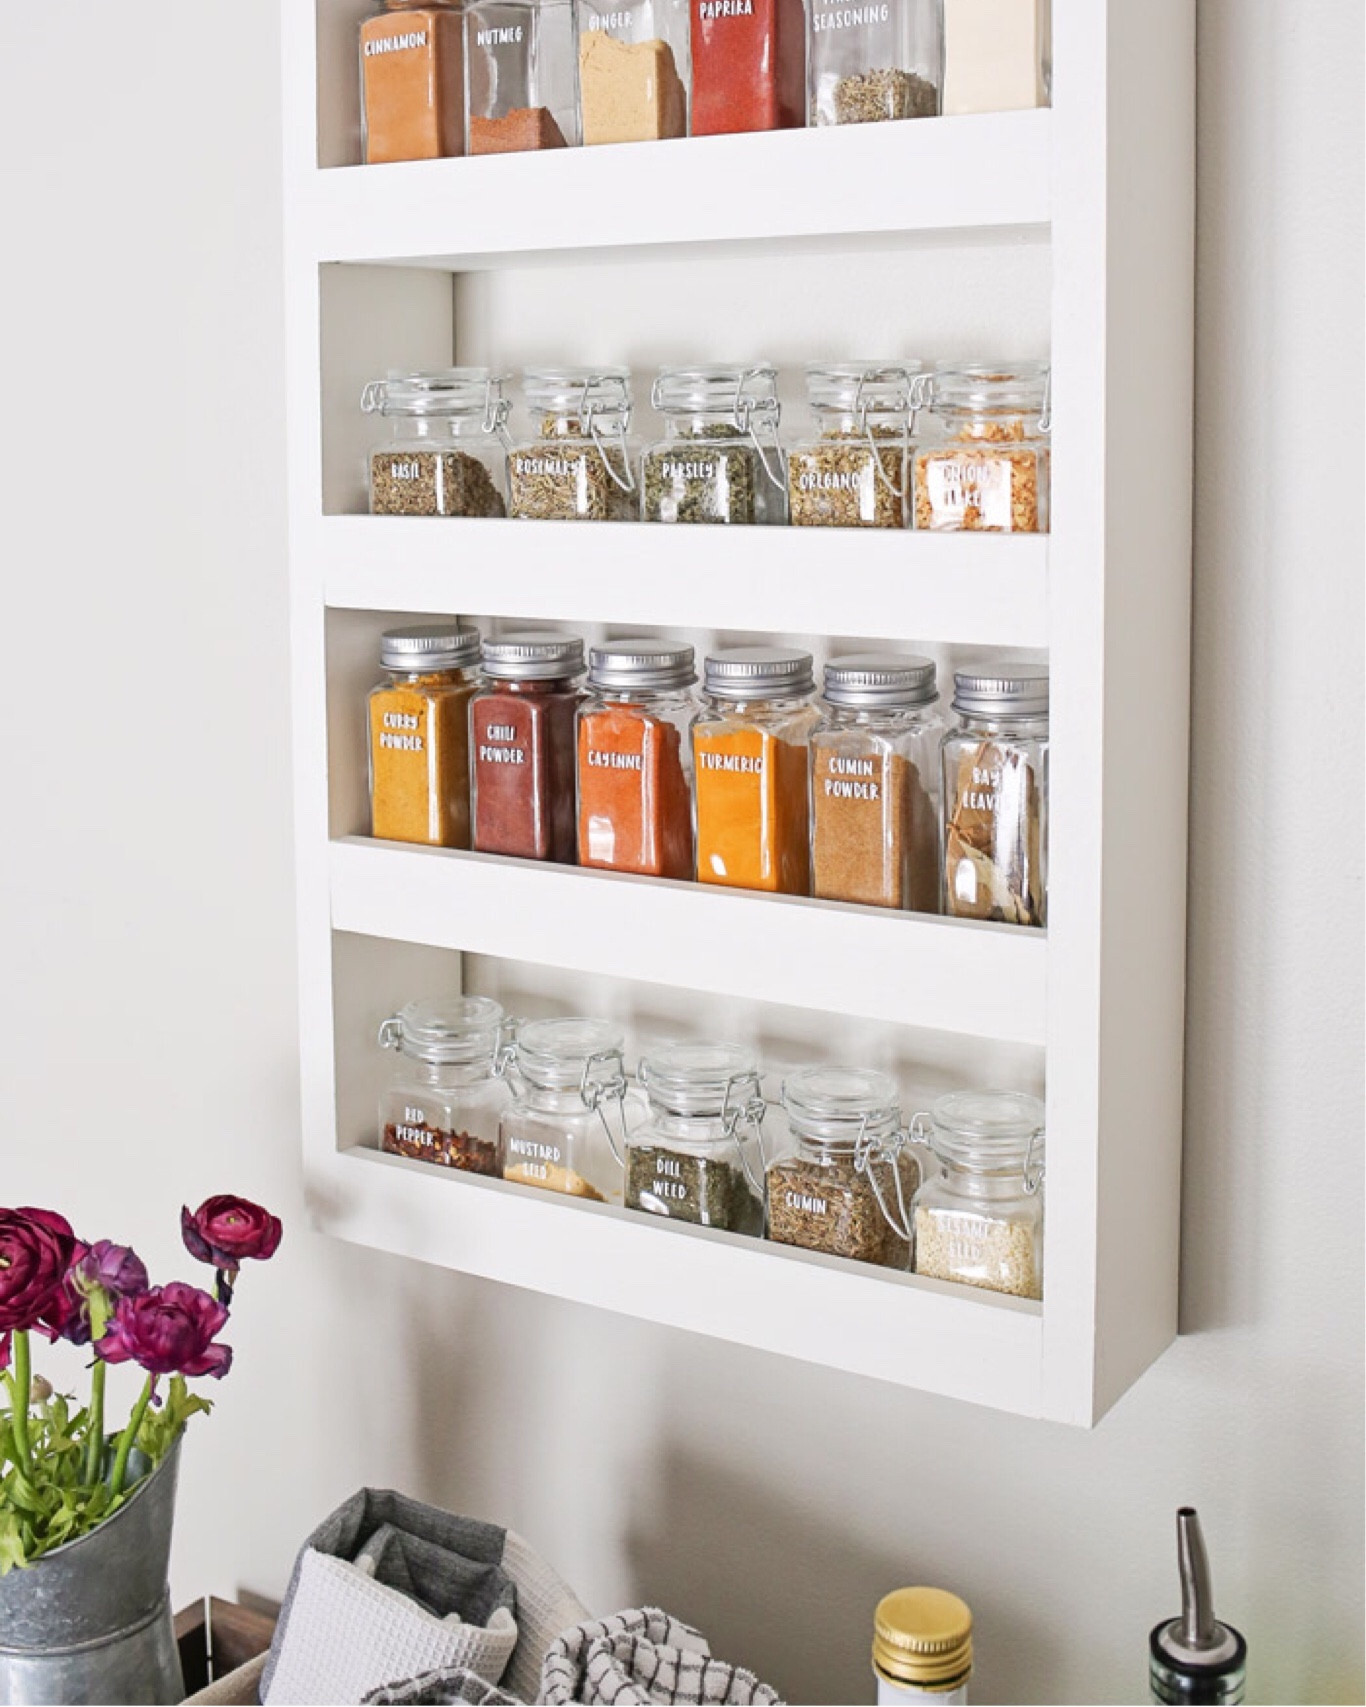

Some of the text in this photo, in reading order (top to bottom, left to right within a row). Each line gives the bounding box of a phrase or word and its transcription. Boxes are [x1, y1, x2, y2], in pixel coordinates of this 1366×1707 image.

[700, 0, 753, 19] PAPRIKA
[813, 4, 888, 33] SEASONING
[588, 11, 633, 31] GINGER
[364, 31, 427, 56] CINNAMON
[477, 26, 523, 46] NUTMEG
[391, 463, 420, 481] BASIL
[662, 462, 714, 478] PARSLEY
[802, 473, 860, 490] OREGANO
[383, 712, 419, 730] CURRY
[379, 732, 424, 751] POWDER
[487, 724, 516, 741] CHILI
[479, 745, 525, 765] POWDER
[588, 750, 641, 770] CAYENNE
[700, 751, 763, 774] TURMERIC
[828, 757, 873, 776] CUMIN
[972, 767, 1000, 787] BAY
[824, 779, 880, 800] POWDER
[405, 1106, 425, 1122] RED
[395, 1125, 434, 1146] PEPPER
[510, 1137, 561, 1162] MUSTARD
[656, 1157, 680, 1177] DILL
[653, 1180, 686, 1199] WEED
[785, 1191, 827, 1214] CUMIN
